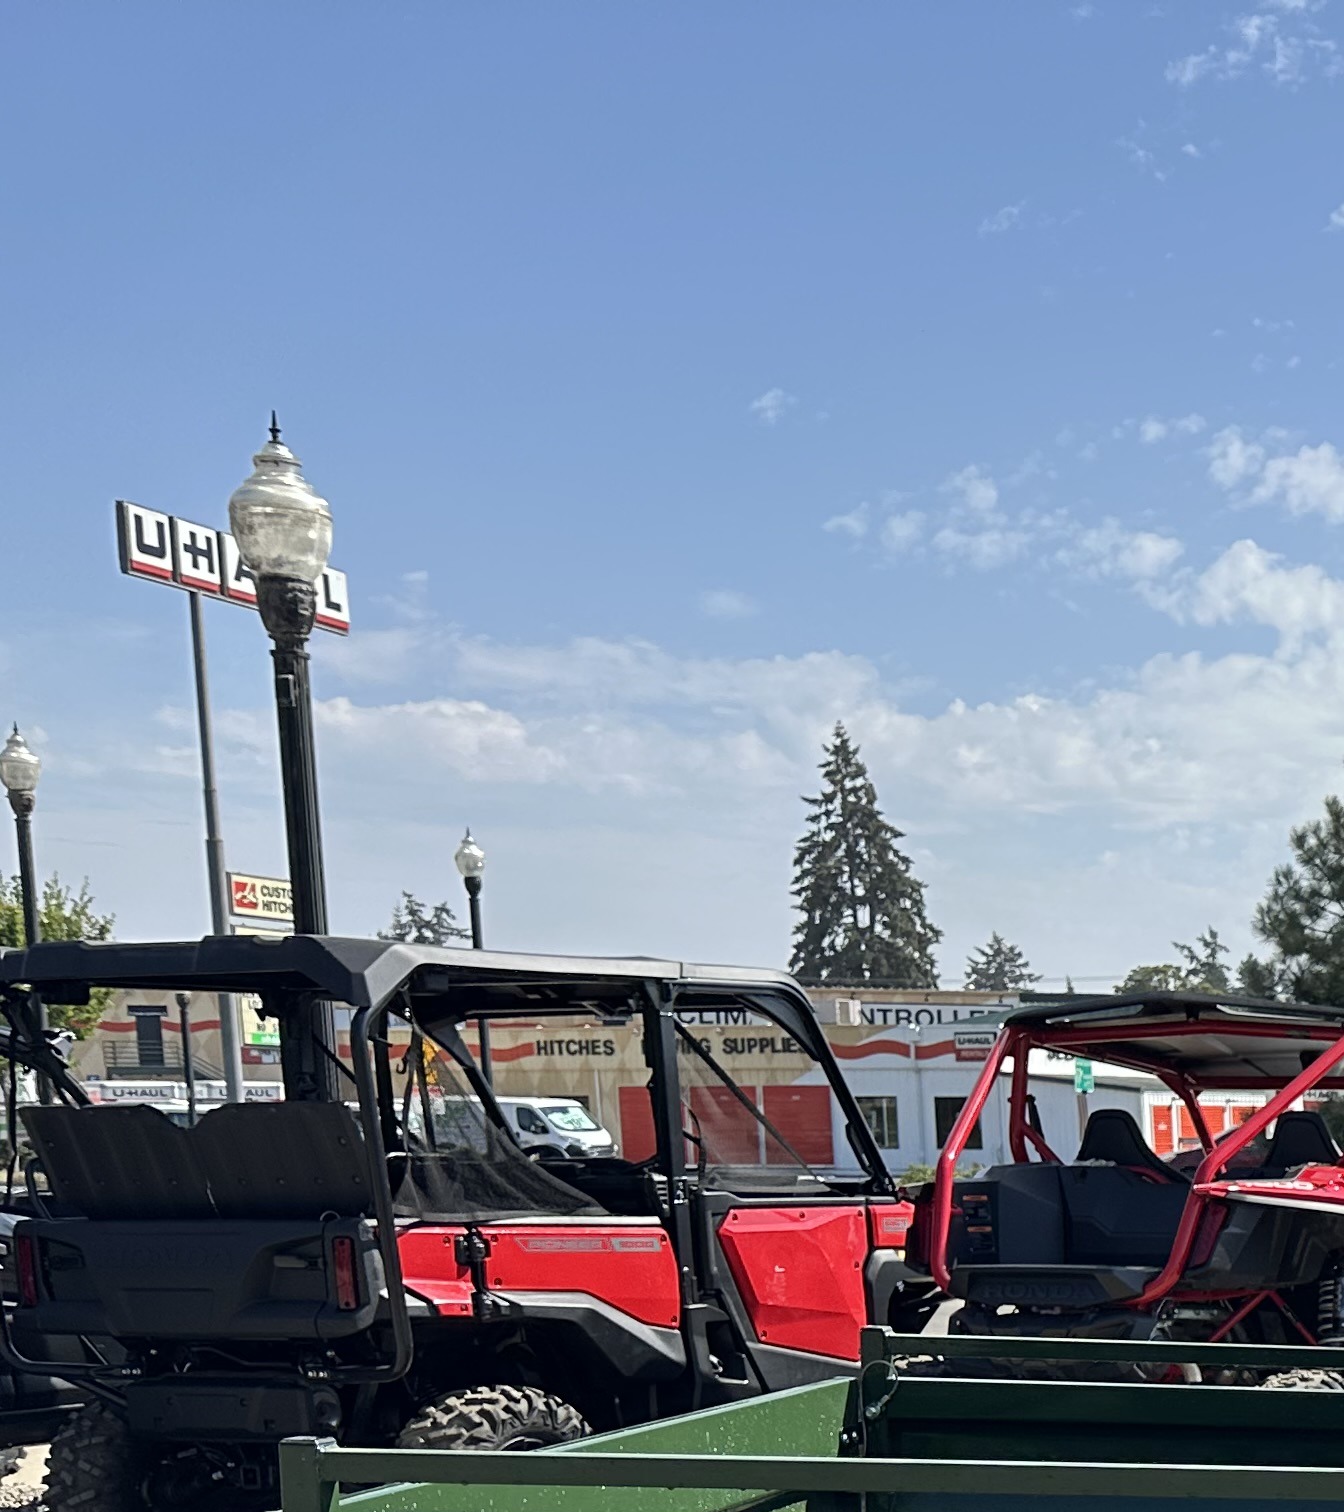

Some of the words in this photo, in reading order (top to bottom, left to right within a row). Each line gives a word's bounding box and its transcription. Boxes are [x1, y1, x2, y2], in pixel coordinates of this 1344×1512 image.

[134, 513, 342, 612] U-HL
[536, 1039, 615, 1056] HITCHES
[112, 1087, 168, 1098] U-HAUL
[218, 1087, 273, 1098] UAUL
